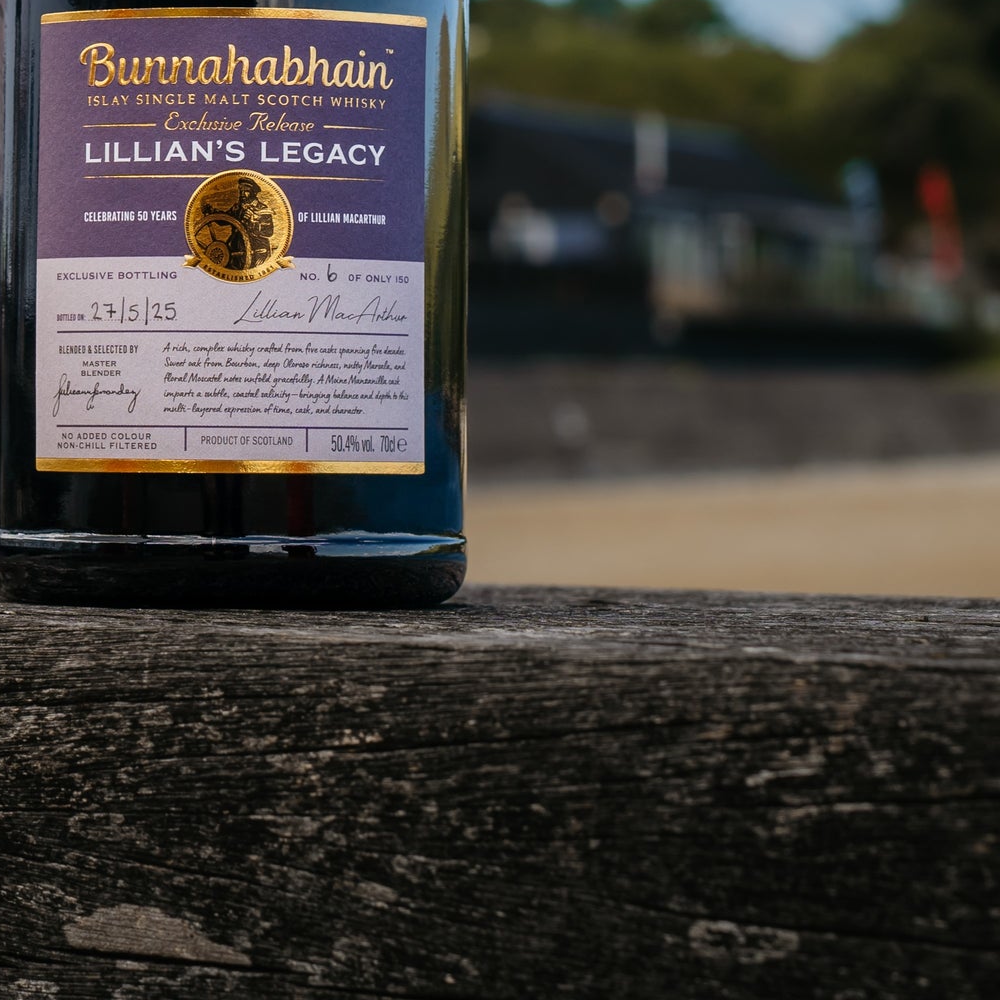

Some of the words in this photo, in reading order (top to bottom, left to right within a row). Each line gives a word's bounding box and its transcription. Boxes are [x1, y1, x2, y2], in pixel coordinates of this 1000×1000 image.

[79, 42, 394, 90] Bunnahabhain
[87, 95, 129, 106] ISLAY
[136, 93, 196, 105] SINGLE
[204, 93, 249, 105] MALT
[257, 94, 322, 107] SCOTCH
[330, 96, 386, 110] WHISKY
[164, 111, 243, 132] Exclusive
[247, 111, 315, 133] Release
[84, 140, 246, 163] LILLIAN'S
[261, 142, 386, 166] LEGACY
[83, 211, 135, 222] CELEBRATING
[137, 210, 149, 221] 50
[151, 210, 177, 221] YEARS
[298, 212, 309, 222] OF
[310, 212, 341, 224] LILLIAN
[343, 213, 386, 225] MACARTHUR
[56, 272, 114, 281] EXCLUSIVE
[118, 271, 177, 280] BOTTLING
[300, 272, 320, 281] NO.
[348, 274, 361, 282] OF
[365, 274, 392, 283] ONLY
[395, 275, 410, 284] 150
[233, 290, 305, 325] Lillian
[56, 313, 77, 321] BOTTLED
[59, 345, 86, 354] BLENDED
[88, 345, 92, 354] &
[93, 344, 127, 354] SELECTED
[129, 345, 138, 354] BY
[162, 342, 170, 353] A
[193, 342, 225, 356] complex
[227, 342, 255, 357] whisky
[257, 342, 283, 354] crafted
[285, 343, 303, 354] from
[305, 342, 318, 355] five
[319, 344, 337, 354] casks
[339, 346, 370, 359] spanning
[371, 344, 382, 356] five
[164, 356, 187, 368] Sweet
[188, 358, 201, 367] oak
[203, 357, 225, 369] from
[263, 359, 281, 373] deep
[283, 358, 309, 369] Oloroso
[343, 360, 363, 373] nutty
[394, 362, 406, 371] and
[81, 369, 121, 377] BLENDER
[163, 371, 188, 383] floral
[187, 372, 223, 383] Moscatel
[223, 374, 242, 383] notes
[243, 372, 272, 385] unfold
[317, 373, 324, 384] A
[163, 388, 194, 401] imparts
[232, 388, 261, 398] coastal
[332, 389, 359, 400] balance
[360, 390, 374, 400] and
[375, 390, 392, 405] depth
[163, 402, 223, 418] multi-layered
[224, 404, 261, 418] expression
[264, 403, 273, 414] of
[315, 404, 330, 414] and
[61, 432, 74, 440] NO
[77, 432, 107, 440] ADDED
[111, 432, 152, 440] COLOUR
[200, 435, 238, 445] PRODUCT
[240, 435, 250, 445] OF
[252, 435, 293, 446] SCOTLAND
[331, 434, 360, 452] 50.4%
[57, 441, 106, 450] NON-CHILL
[109, 442, 157, 450] FILTERED
